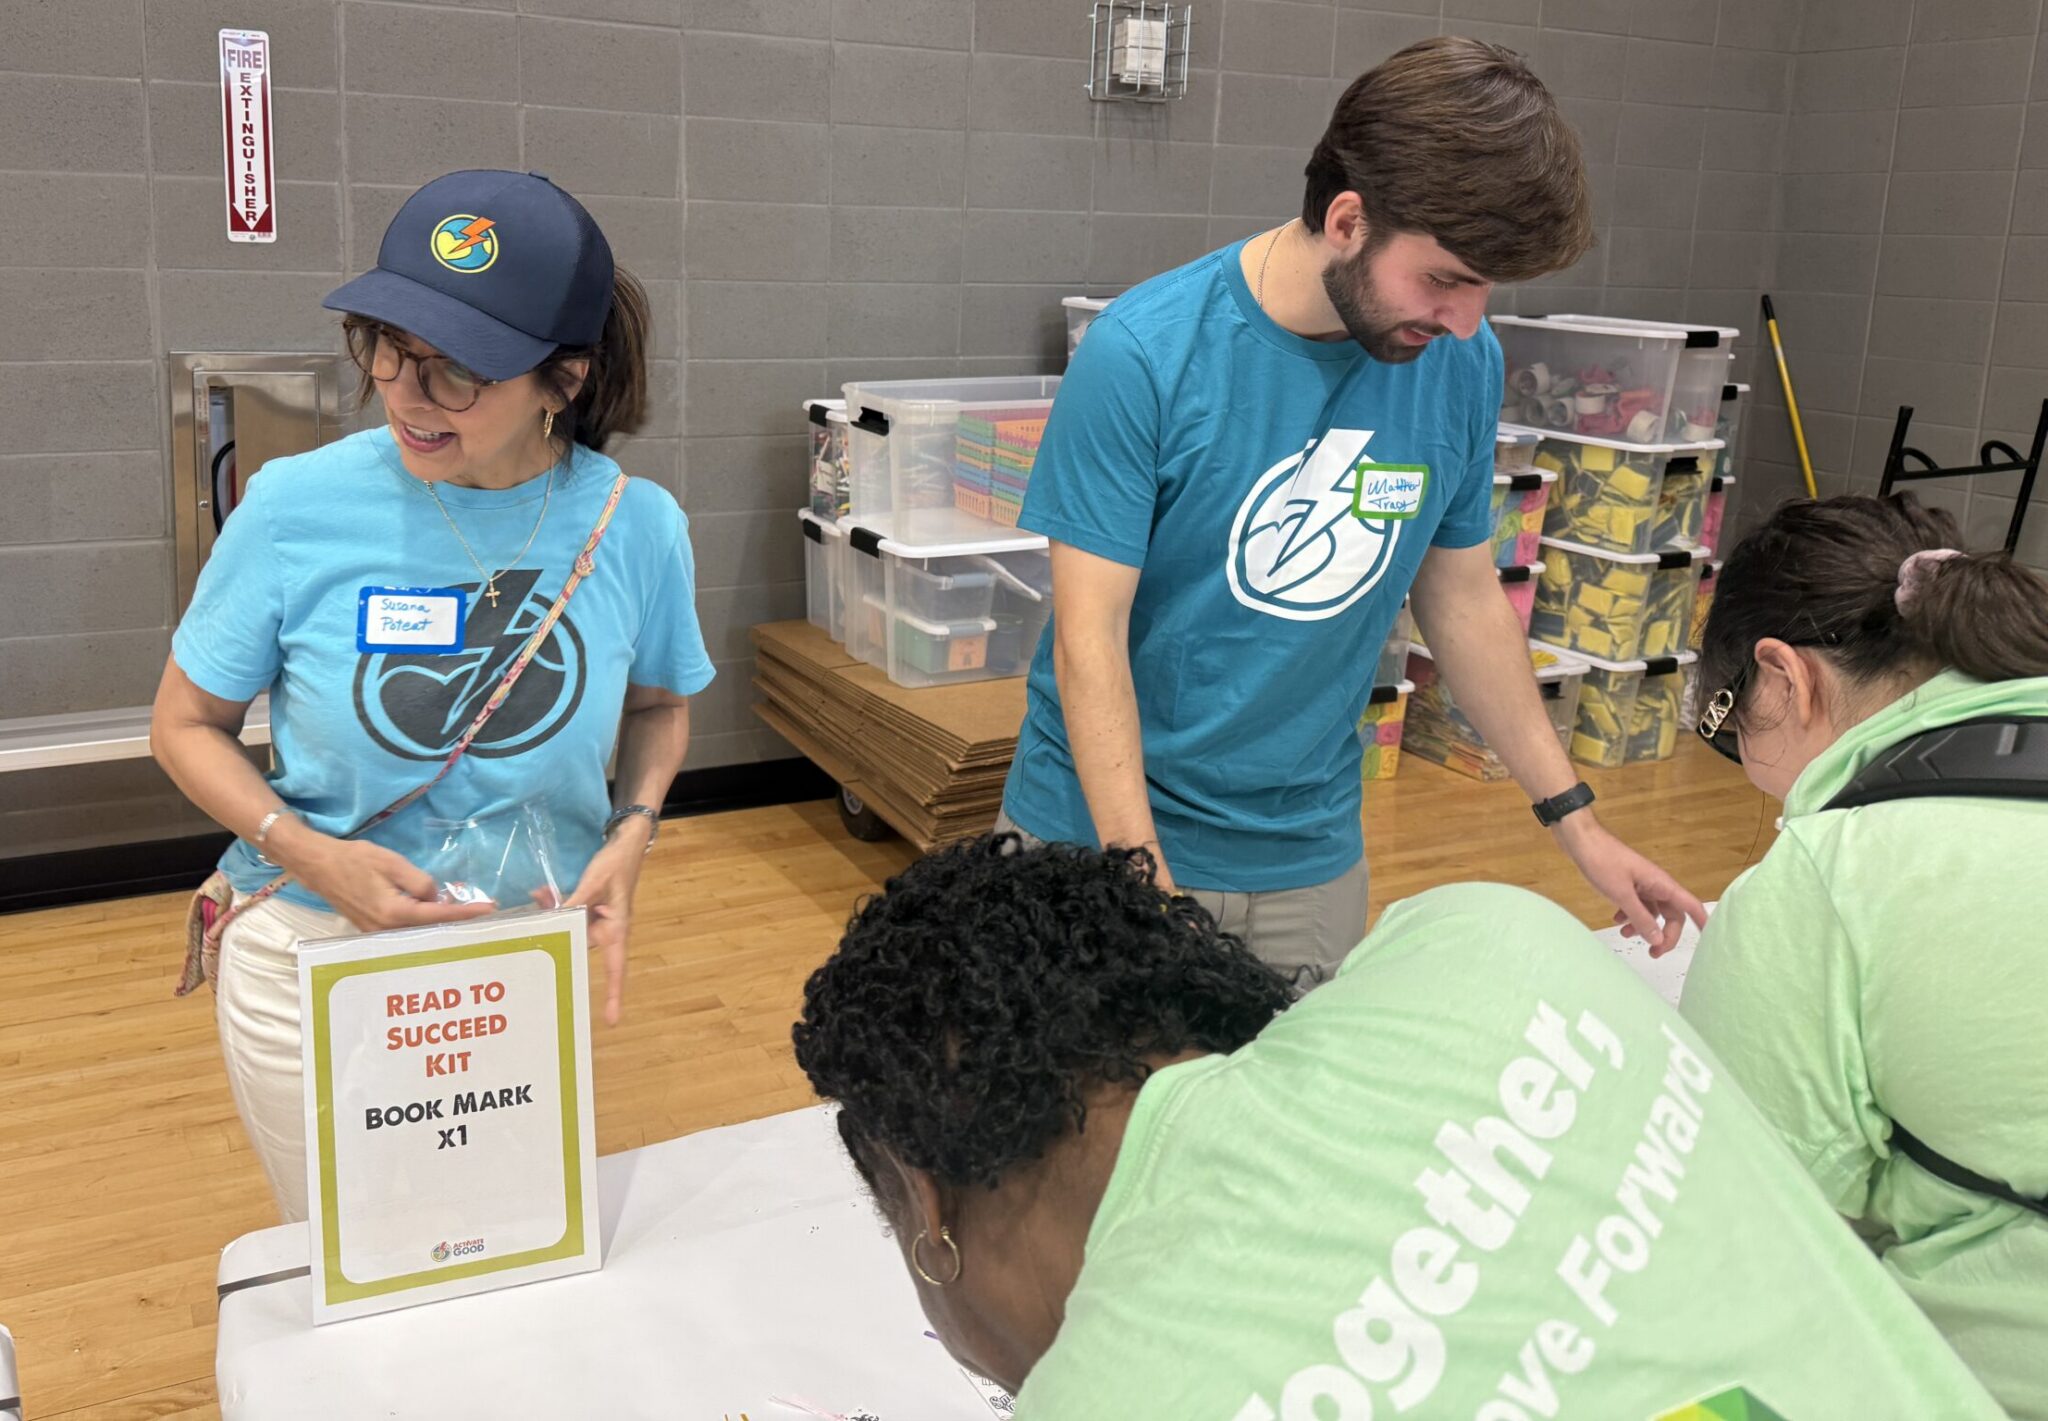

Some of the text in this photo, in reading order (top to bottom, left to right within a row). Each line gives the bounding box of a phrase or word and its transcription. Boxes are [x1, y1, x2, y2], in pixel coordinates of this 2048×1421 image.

[227, 49, 262, 69] FIRE
[240, 72, 257, 221] EXTINGUISHER
[386, 981, 506, 1018] READ TO
[386, 1014, 508, 1050] SUCCEED
[425, 1051, 472, 1078] KIT
[365, 1084, 534, 1130] BOOK MARK
[1555, 1022, 1714, 1328] Forward
[453, 1244, 485, 1257] GOOD
